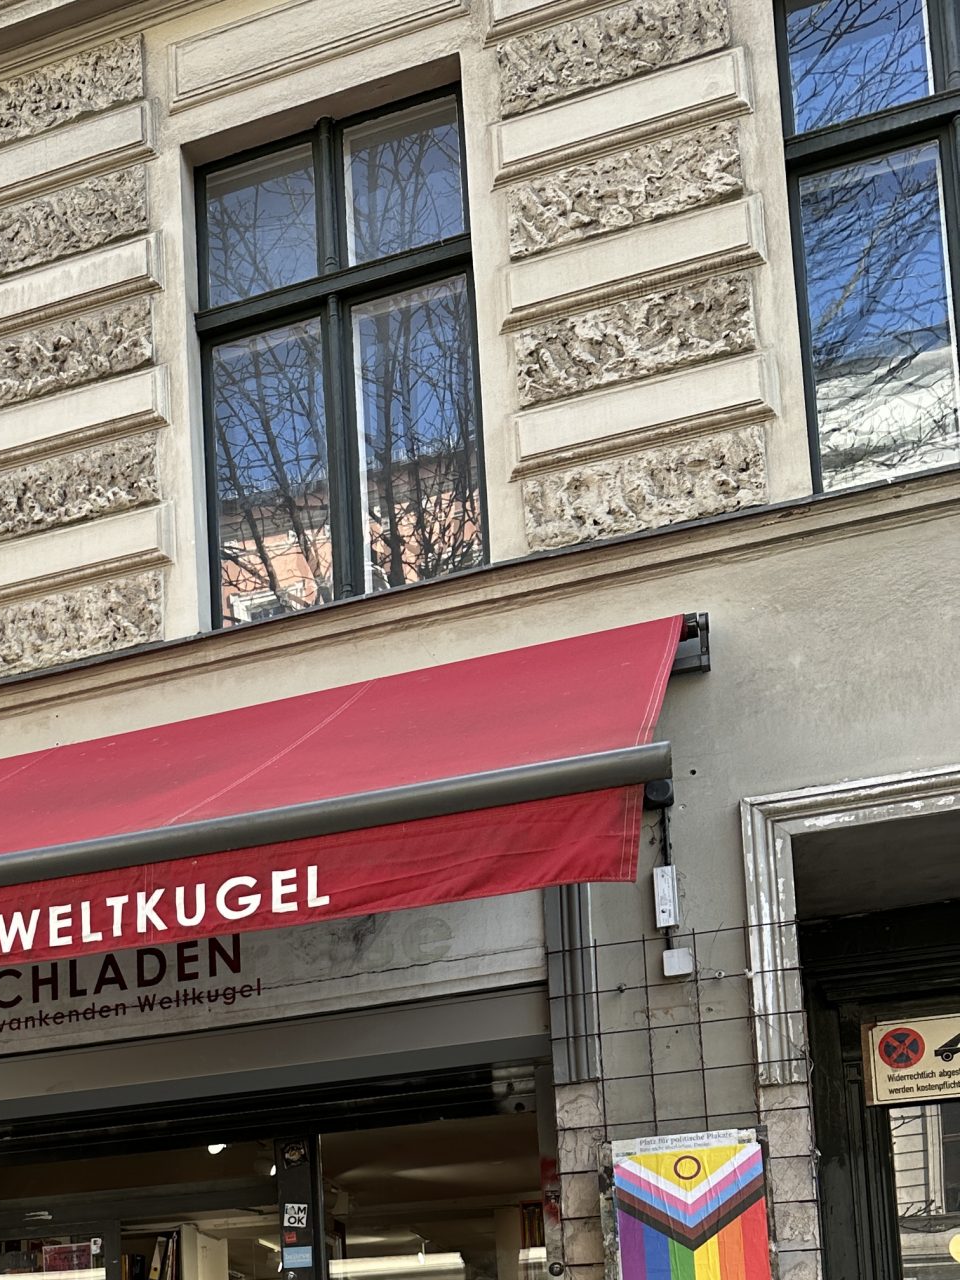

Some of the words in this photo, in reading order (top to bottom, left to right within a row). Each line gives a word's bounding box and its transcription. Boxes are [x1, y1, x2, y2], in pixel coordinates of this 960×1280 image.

[137, 978, 262, 1012] Weltkugel
[887, 1070, 936, 1082] Widerrechtlich
[888, 1085, 914, 1095] werden
[639, 1138, 656, 1147] Platz
[658, 1136, 669, 1145] für
[670, 1133, 705, 1145] politische
[706, 1131, 732, 1141] Plakate
[287, 1216, 306, 1226] OK
